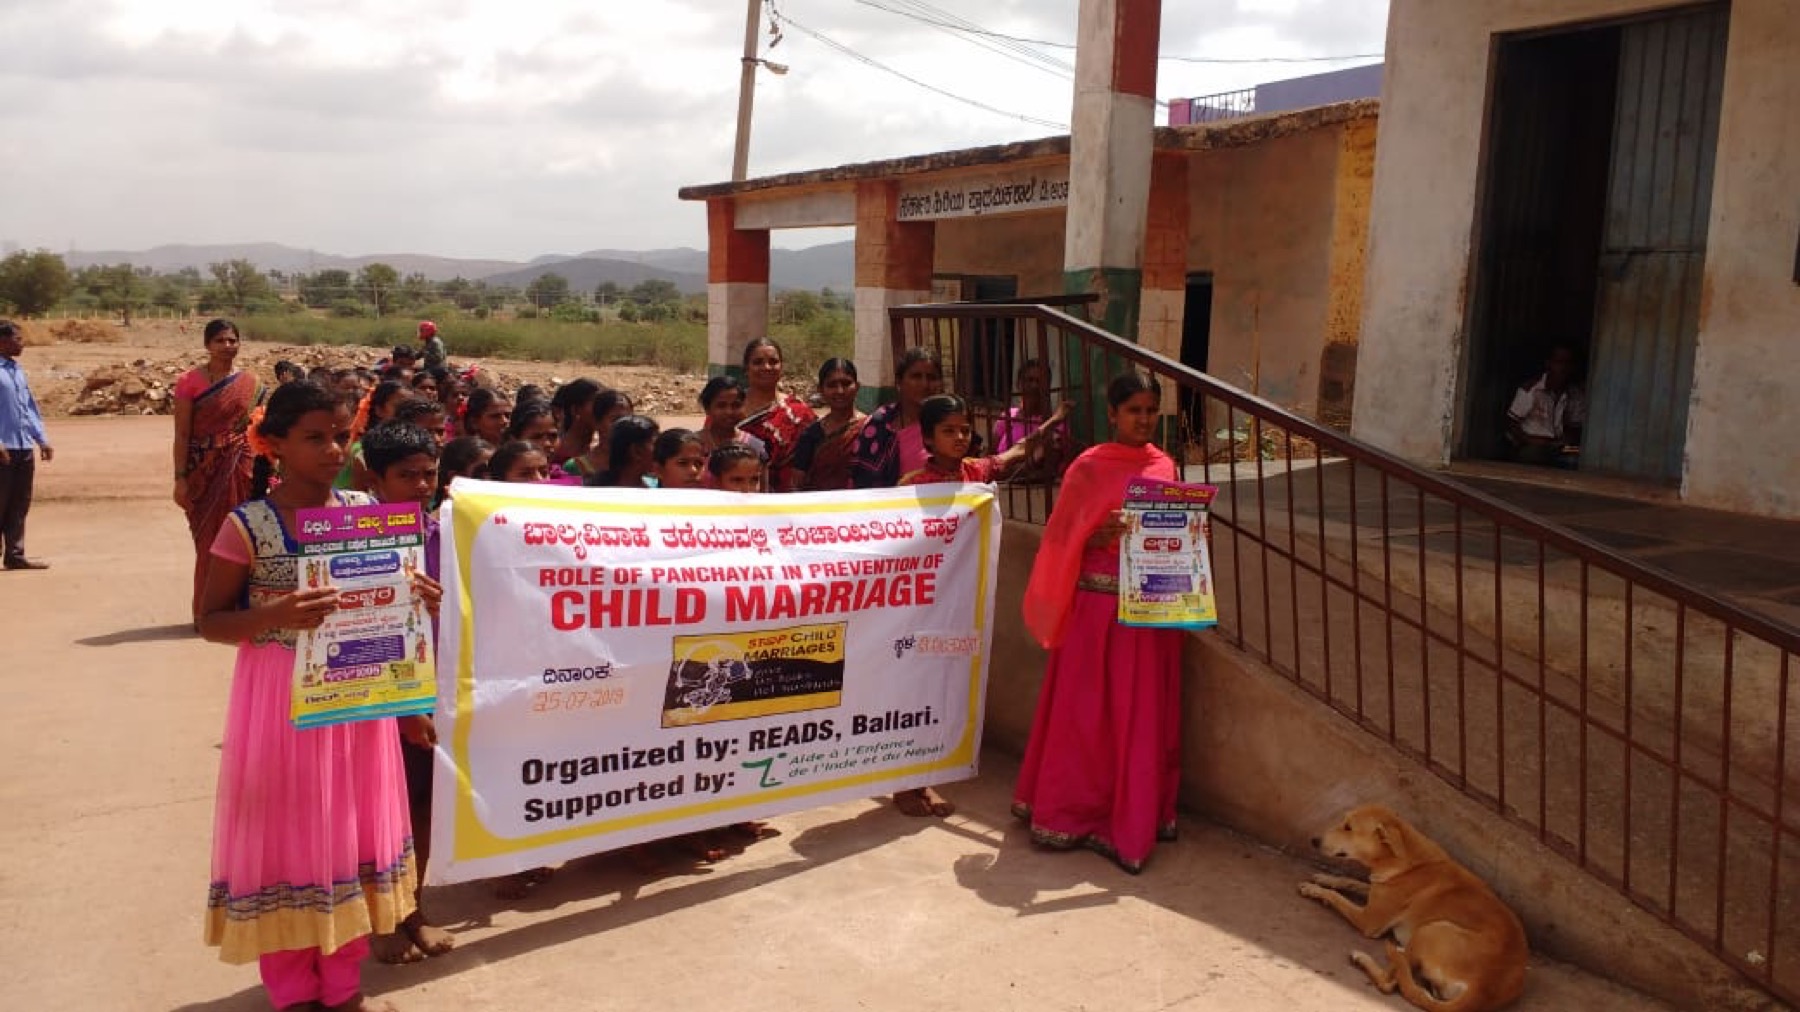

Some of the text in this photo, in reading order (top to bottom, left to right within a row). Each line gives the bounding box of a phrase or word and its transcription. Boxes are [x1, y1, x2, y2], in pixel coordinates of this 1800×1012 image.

[523, 521, 651, 560] ಬಾಲ್ಯವಿವಾಹ
[660, 521, 773, 556] ತಡೆಯುವಲ್ಲಿ
[539, 553, 944, 587] ROLE OF PANCHAYAT IN PREVENTION OF
[551, 572, 937, 631] CHILD MARRIAGE
[744, 642, 836, 662] MARRIAGES
[747, 629, 837, 649] STOP CHILD
[522, 706, 939, 785] Organized by: READS, Ballari.
[789, 752, 825, 766] Aide
[788, 767, 808, 778] de
[862, 755, 878, 766] et
[882, 751, 900, 762] du
[524, 771, 735, 822] Supported by:
